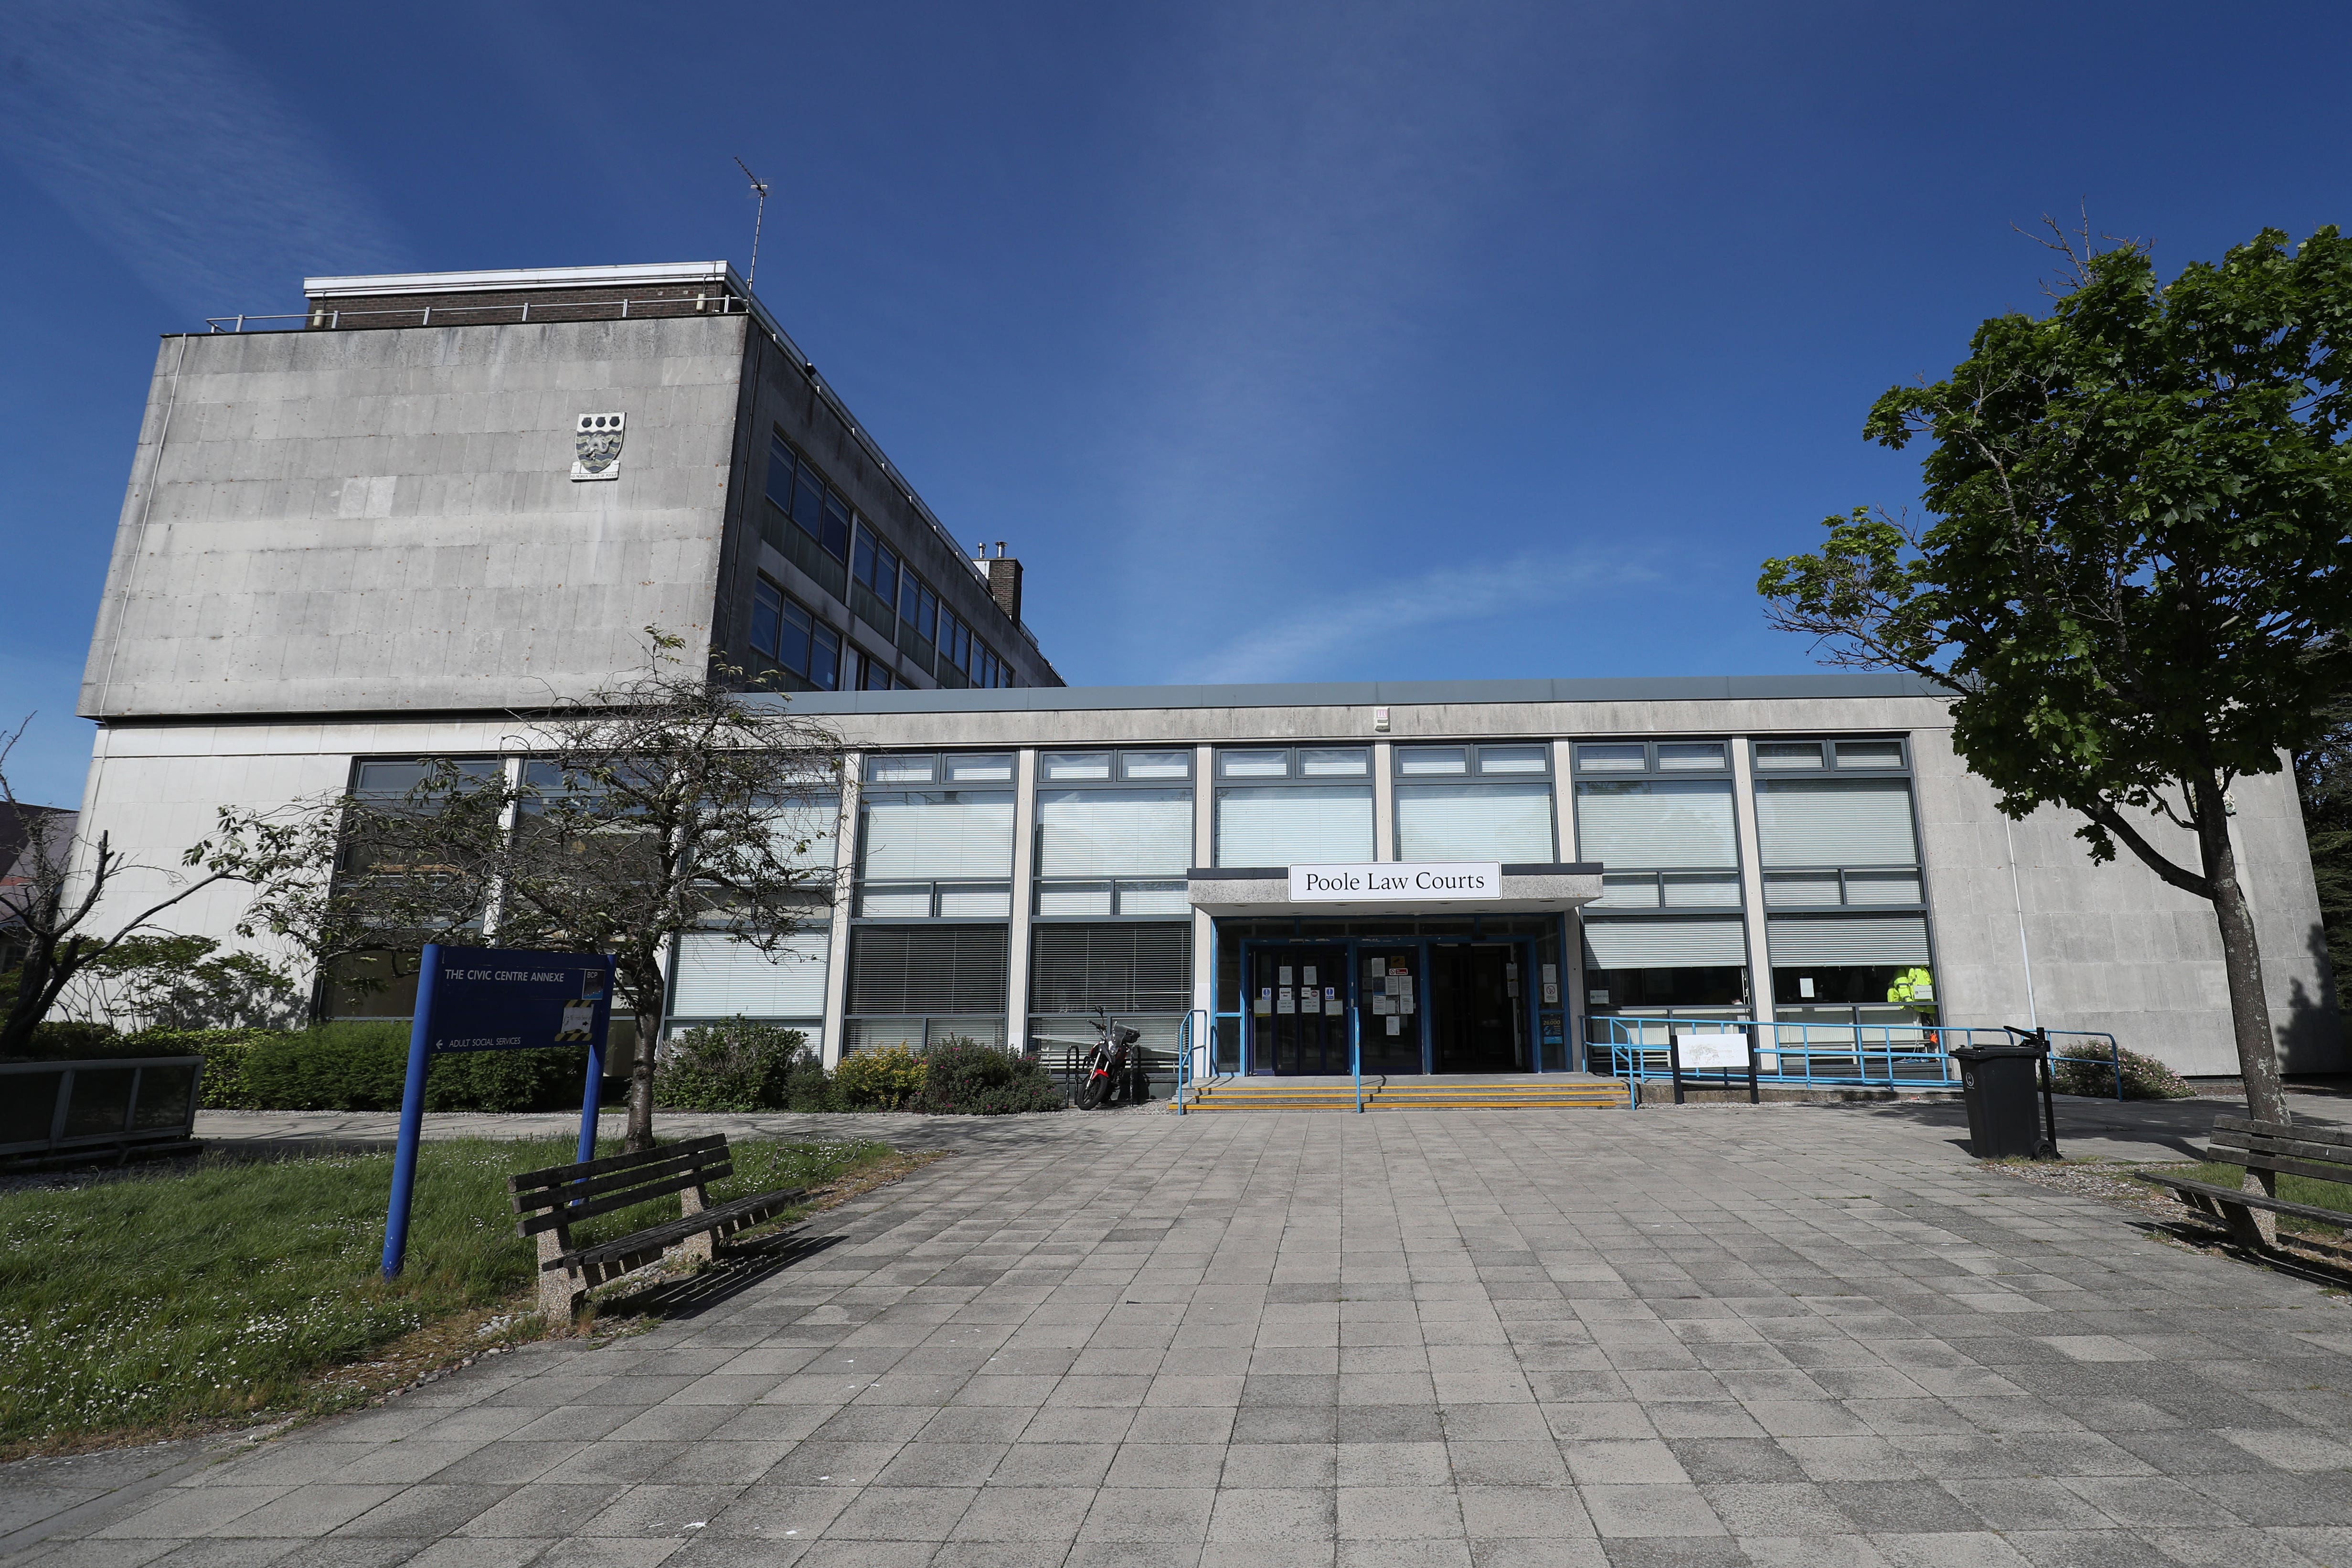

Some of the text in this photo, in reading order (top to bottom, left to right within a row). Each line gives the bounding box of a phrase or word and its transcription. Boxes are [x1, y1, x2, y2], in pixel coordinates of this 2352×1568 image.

[1306, 872, 1485, 891] Poole Law Courts
[445, 969, 564, 982] THE CIVIC CENTRE ANNEXE
[448, 1039, 471, 1047] ADULT
[496, 1037, 521, 1045] SERVICES
